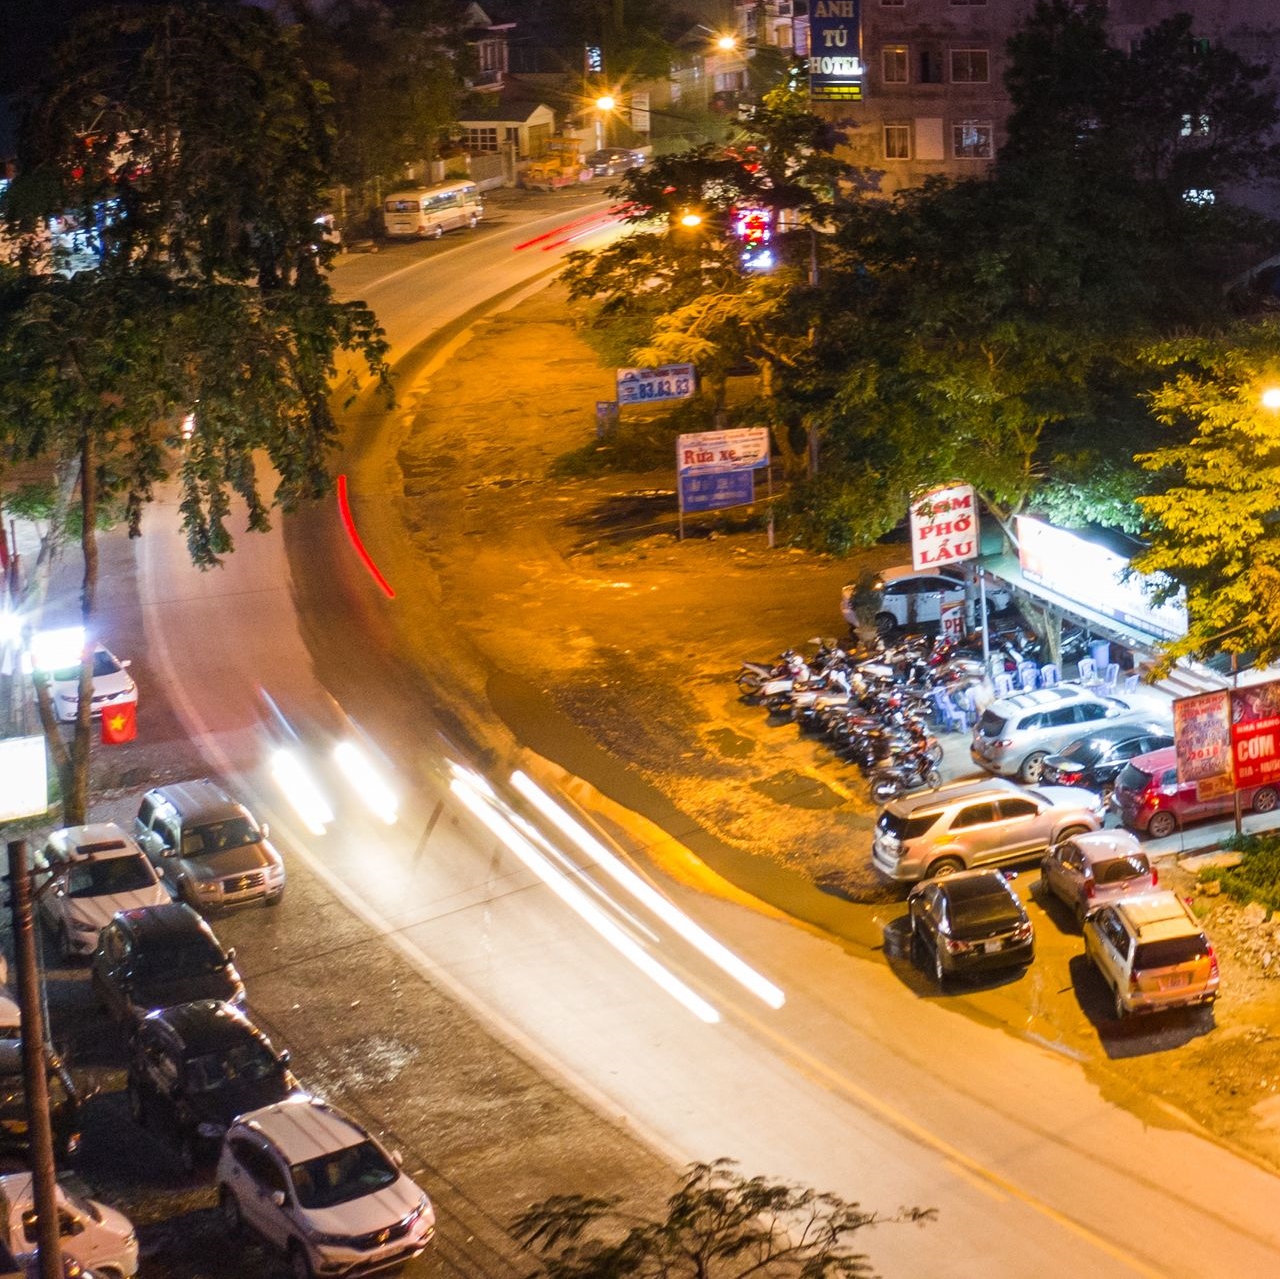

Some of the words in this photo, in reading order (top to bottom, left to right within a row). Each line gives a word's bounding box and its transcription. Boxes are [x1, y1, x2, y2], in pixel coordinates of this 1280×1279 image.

[815, 0, 855, 18] ANH
[822, 24, 849, 48] TÚ
[810, 56, 863, 75] HOTEL
[916, 494, 972, 518] ƠM
[919, 513, 972, 541] PHỞ
[919, 537, 974, 565] LẨU
[1237, 733, 1275, 762] CƠM
